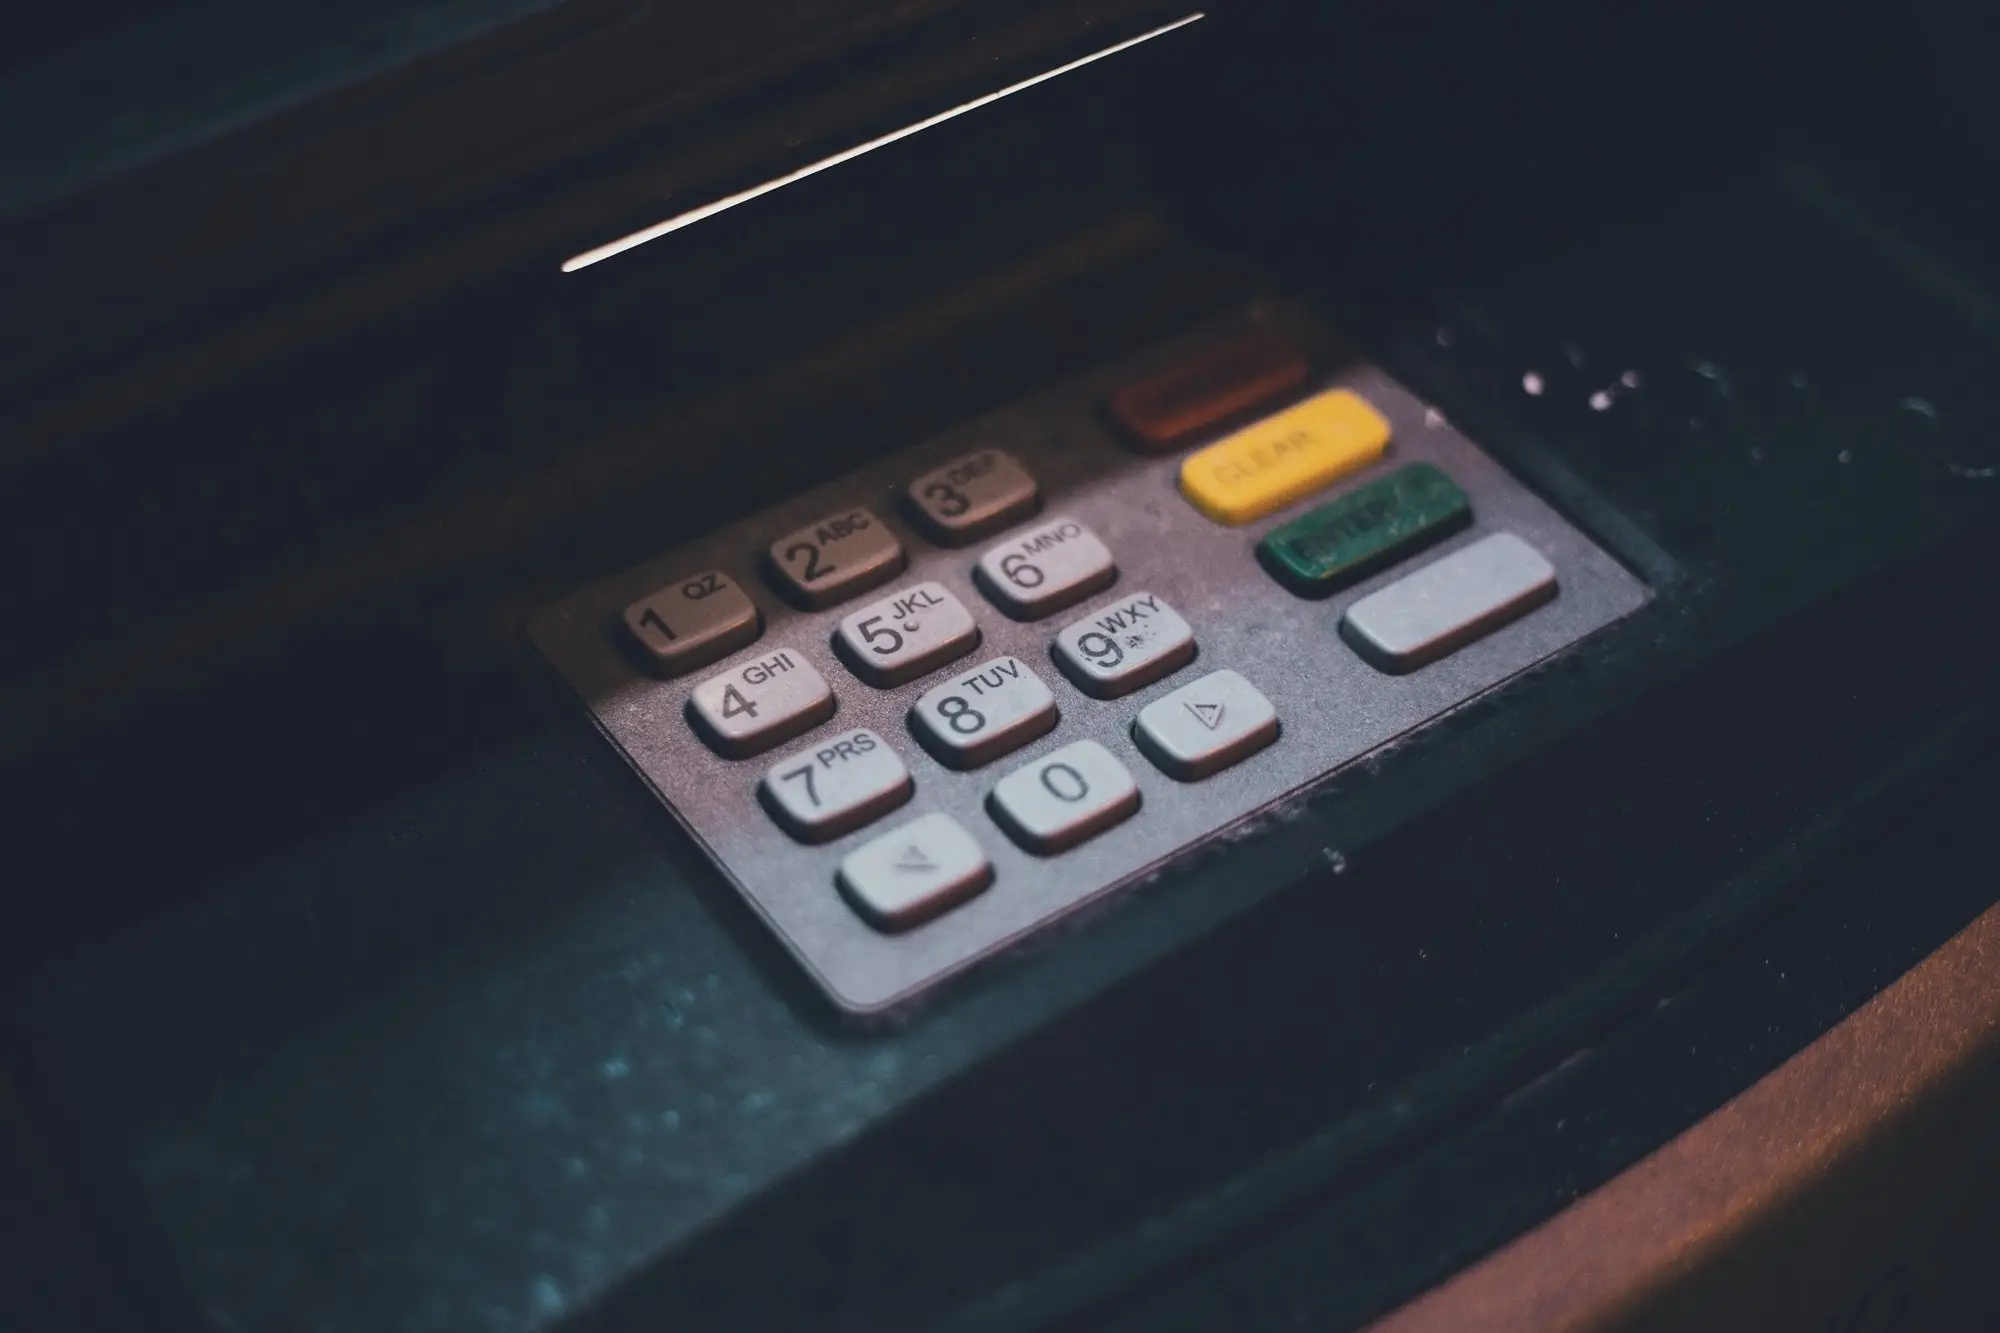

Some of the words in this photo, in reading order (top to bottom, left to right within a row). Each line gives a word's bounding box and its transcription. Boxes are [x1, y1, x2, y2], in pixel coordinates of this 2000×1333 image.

[924, 484, 971, 518] 3
[786, 543, 837, 582] 2
[816, 512, 870, 544] ABC
[1020, 523, 1081, 558] MNO
[1001, 554, 1045, 589] 6
[639, 607, 678, 642] 1
[681, 572, 728, 601] QZ
[856, 615, 904, 656] 5
[892, 590, 945, 621] JKL
[1095, 595, 1160, 634] WXY
[1077, 632, 1124, 668] 9
[720, 683, 760, 719] 4
[742, 652, 796, 686] GHI
[936, 696, 986, 735] 8
[961, 660, 1019, 697] TUV
[781, 764, 824, 808] 7
[817, 732, 878, 770] PRS
[1040, 762, 1090, 802] 0
